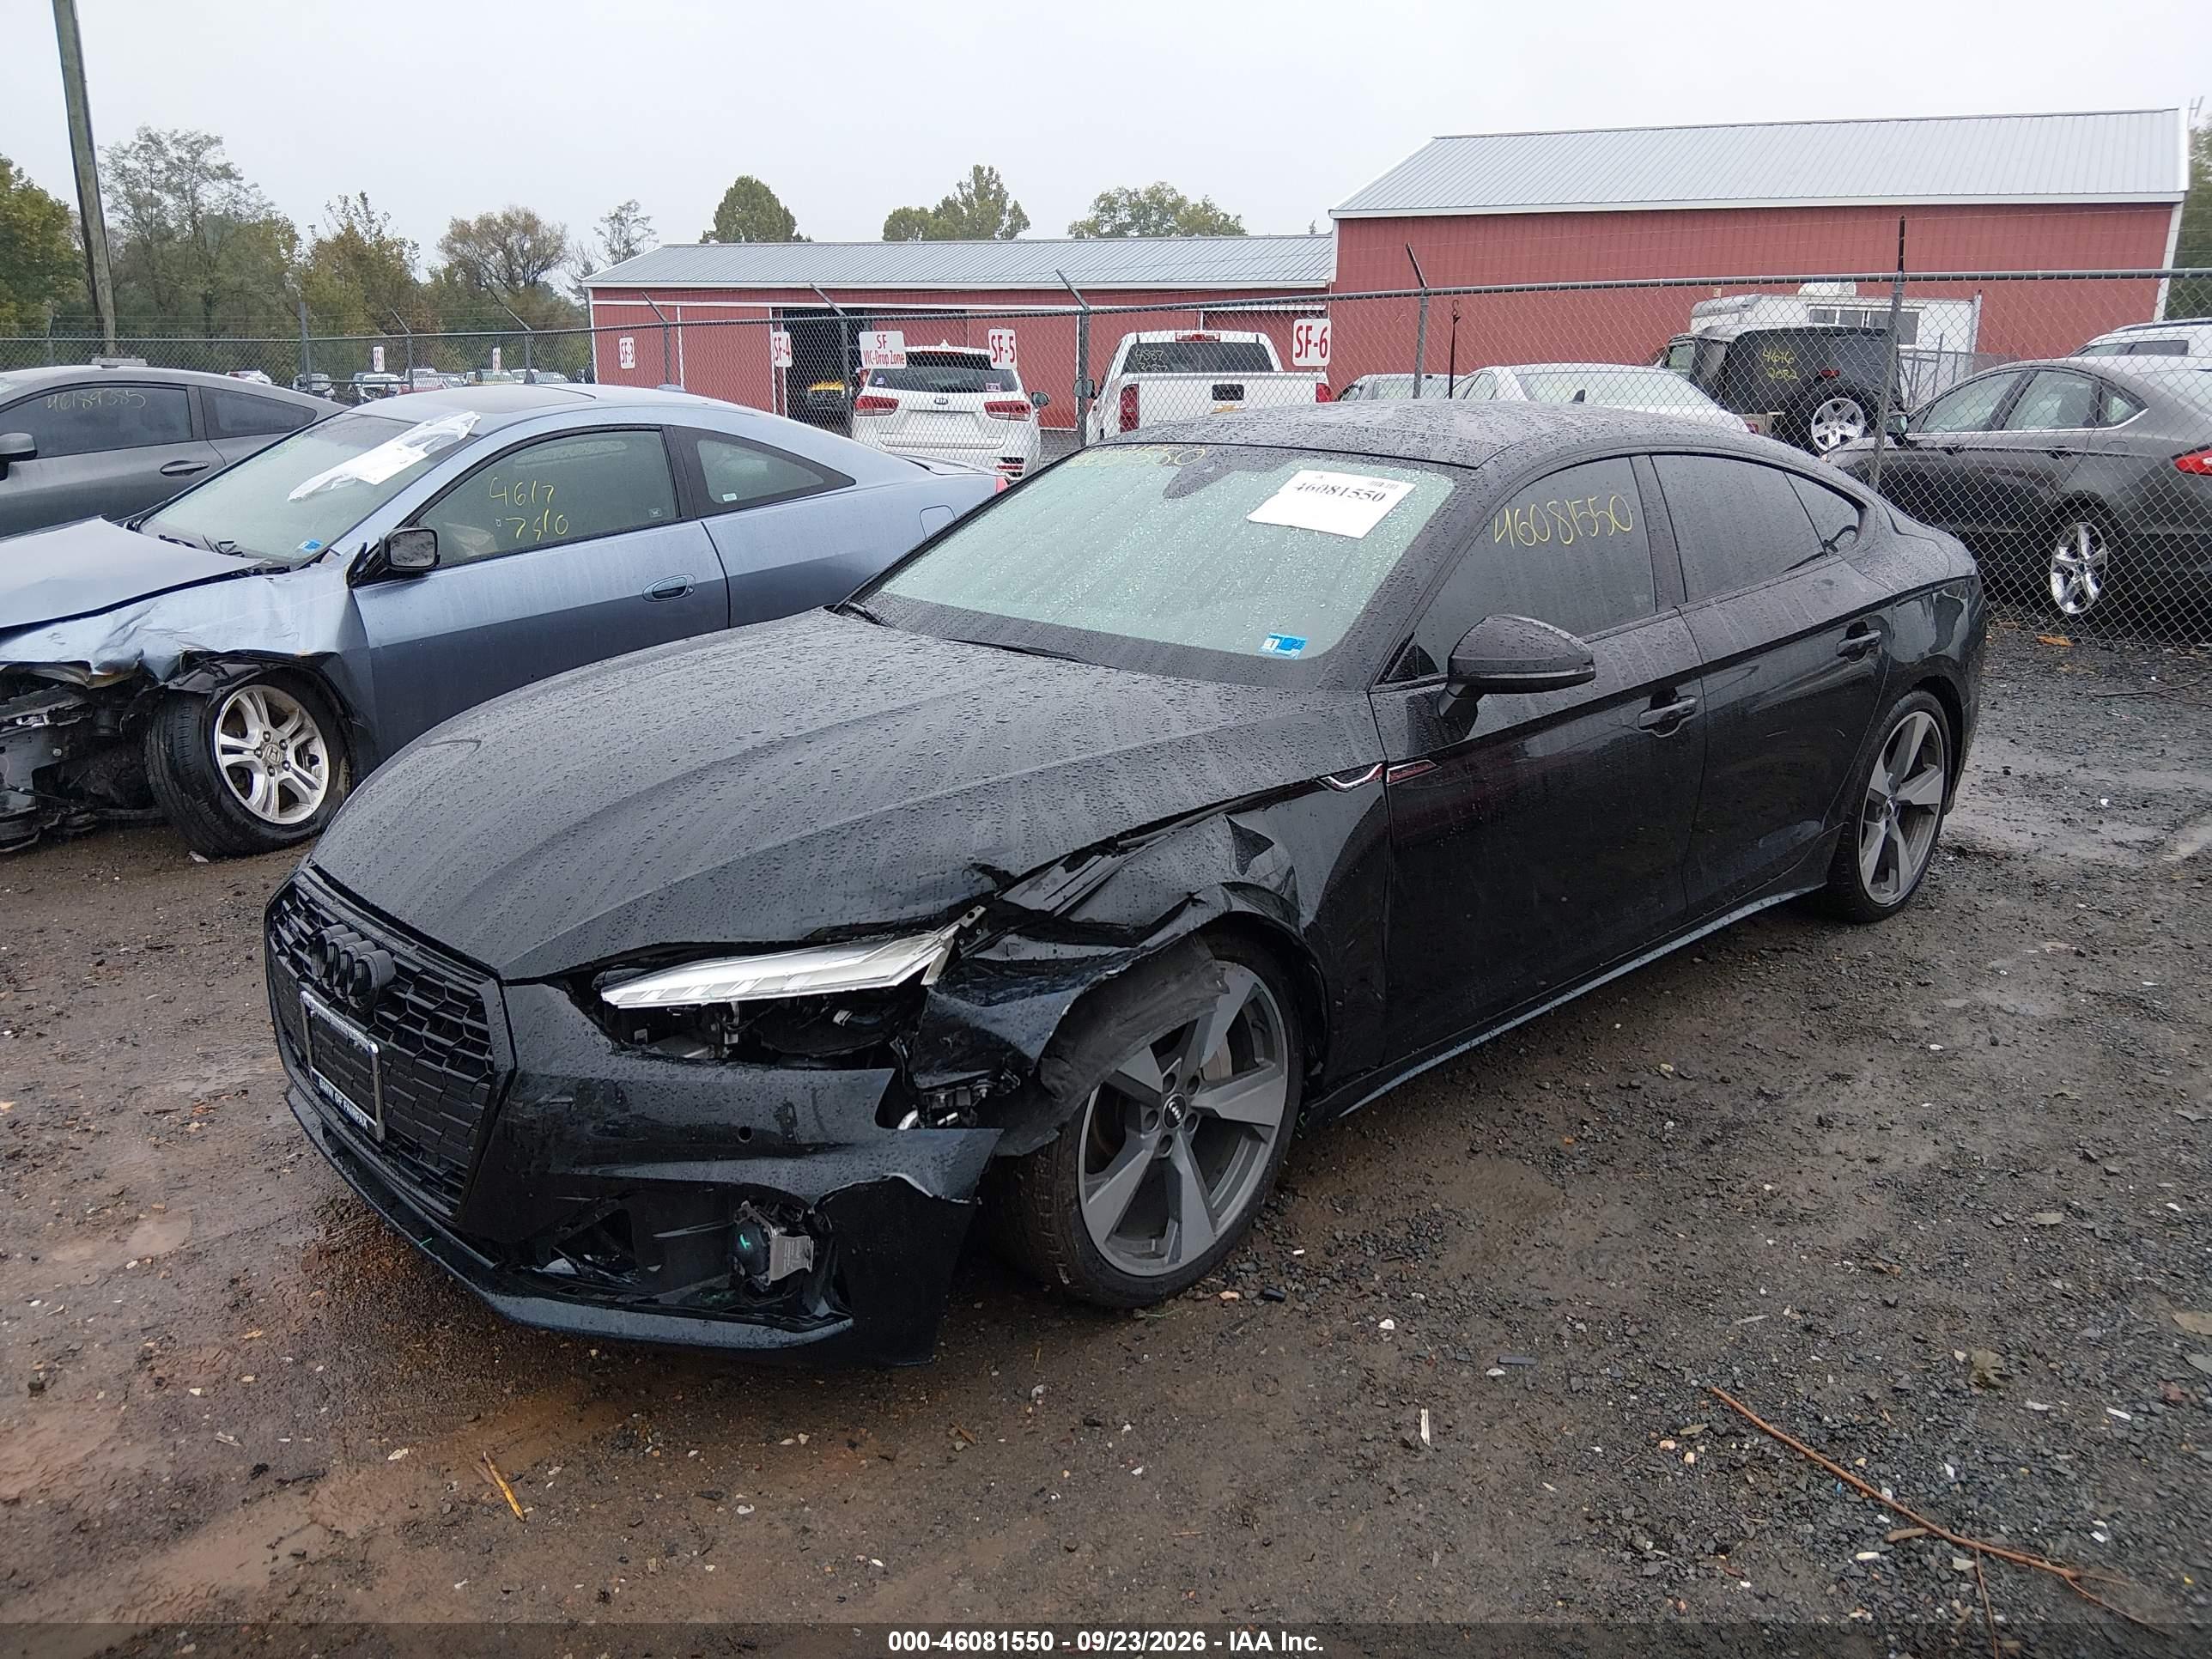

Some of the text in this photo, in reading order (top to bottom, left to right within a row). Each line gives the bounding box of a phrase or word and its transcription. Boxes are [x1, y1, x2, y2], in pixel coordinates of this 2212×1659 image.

[774, 337, 790, 361] SF-4
[876, 334, 887, 349] SF
[991, 335, 1015, 363] SF-5
[1295, 325, 1329, 359] SF-6
[890, 349, 905, 364] Zone
[489, 477, 555, 507] 4617
[1294, 483, 1387, 502] 46081550
[1494, 493, 1633, 550] 46081550
[319, 1078, 368, 1130] BMW OF FAIRFAX
